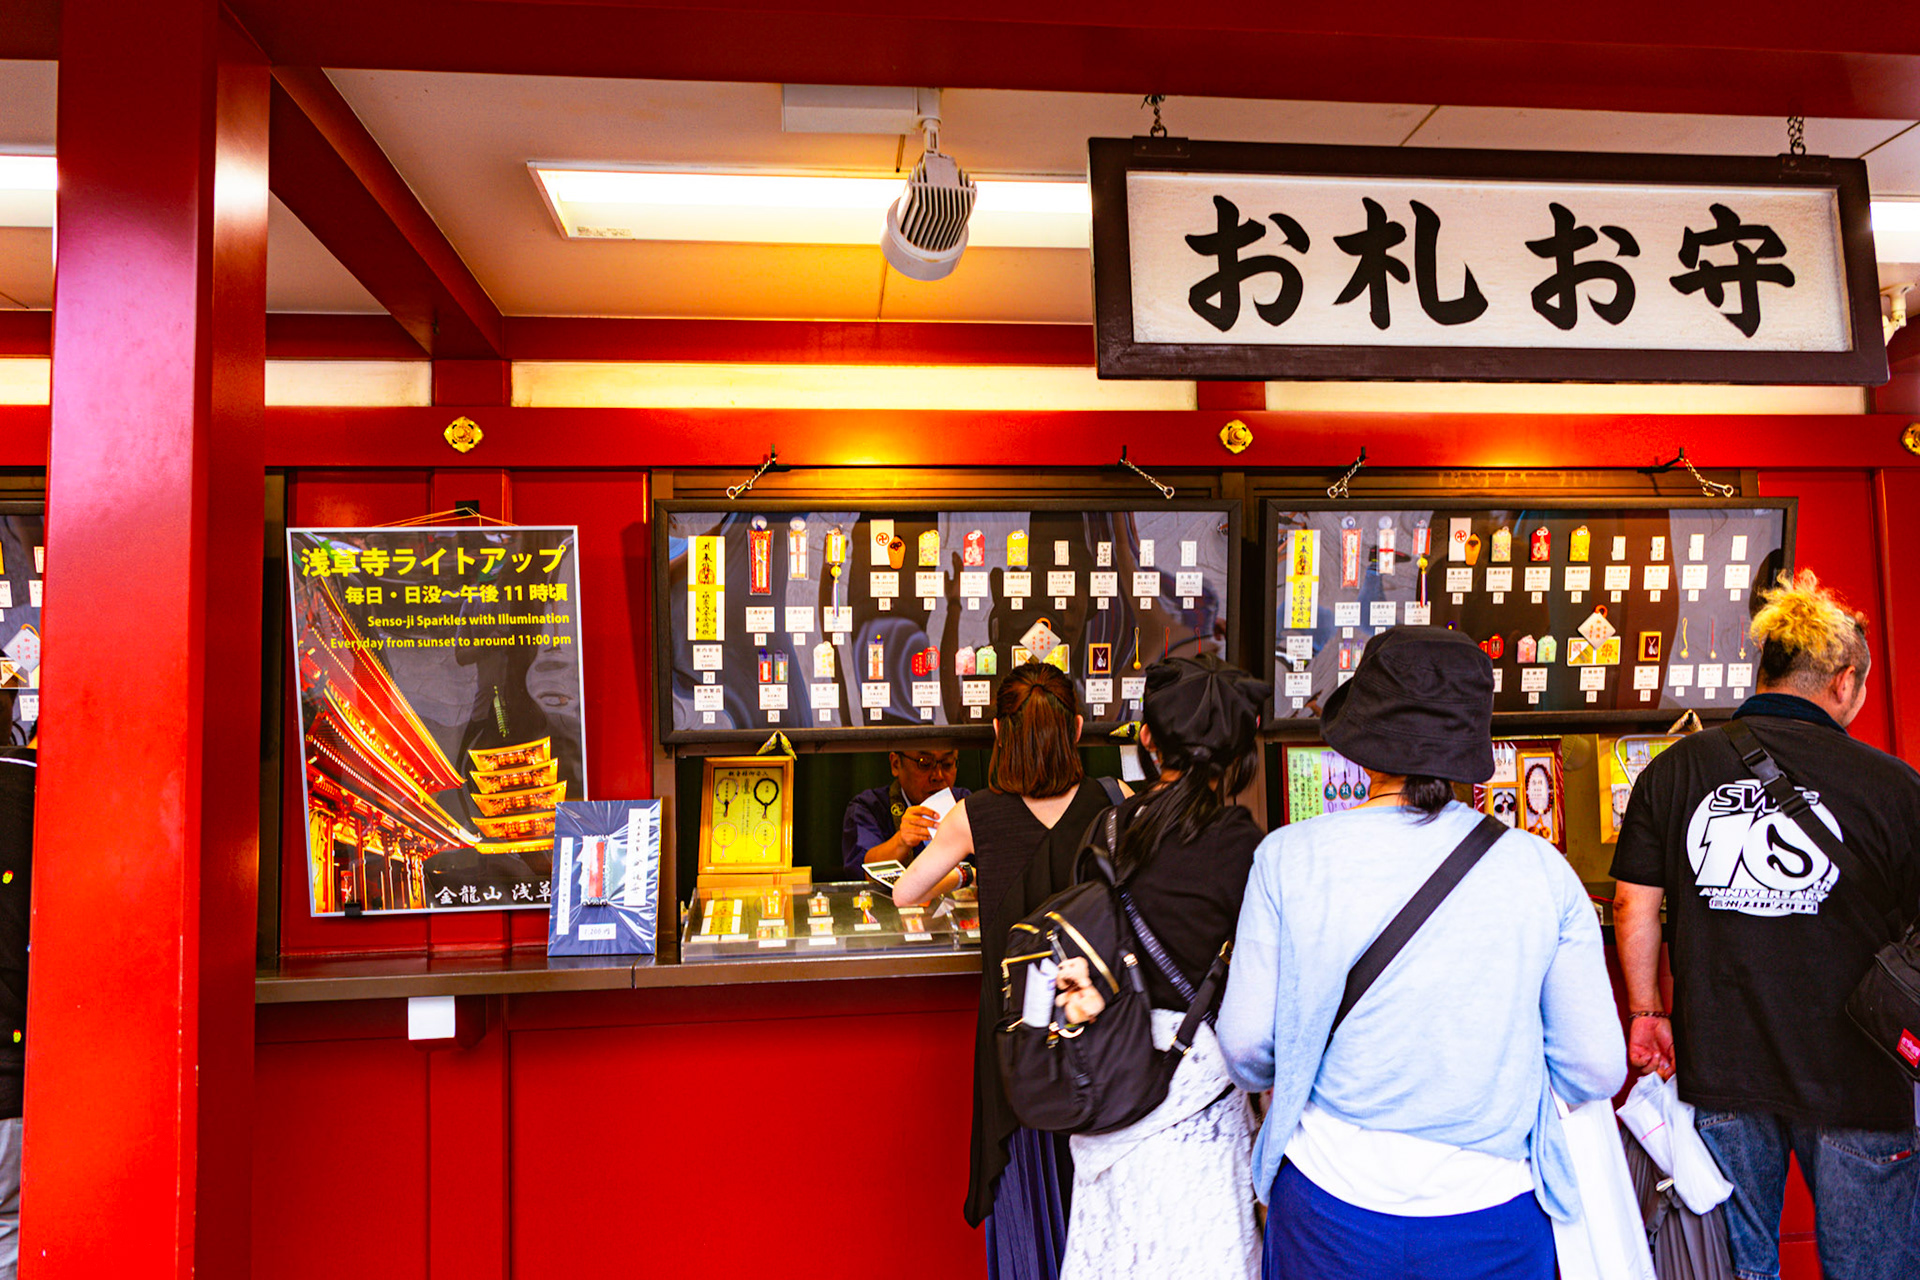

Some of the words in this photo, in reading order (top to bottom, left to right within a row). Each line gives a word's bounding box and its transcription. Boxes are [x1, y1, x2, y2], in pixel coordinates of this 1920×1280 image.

[301, 544, 566, 578] 浅草寺ライトアップ
[367, 615, 415, 628] Senso-ji
[417, 614, 467, 628] Sparkles
[469, 613, 496, 625] with
[498, 612, 570, 625] Illumination
[330, 637, 385, 650] Everyday
[386, 636, 415, 649] from
[417, 637, 456, 648] sunset
[458, 636, 471, 647] to
[473, 635, 516, 647] around
[518, 634, 550, 646] 11:00
[552, 636, 572, 648] pm
[435, 884, 503, 905] 金龍山
[511, 880, 552, 903] 浅草
[1699, 887, 1829, 902] ANNIVERSARY
